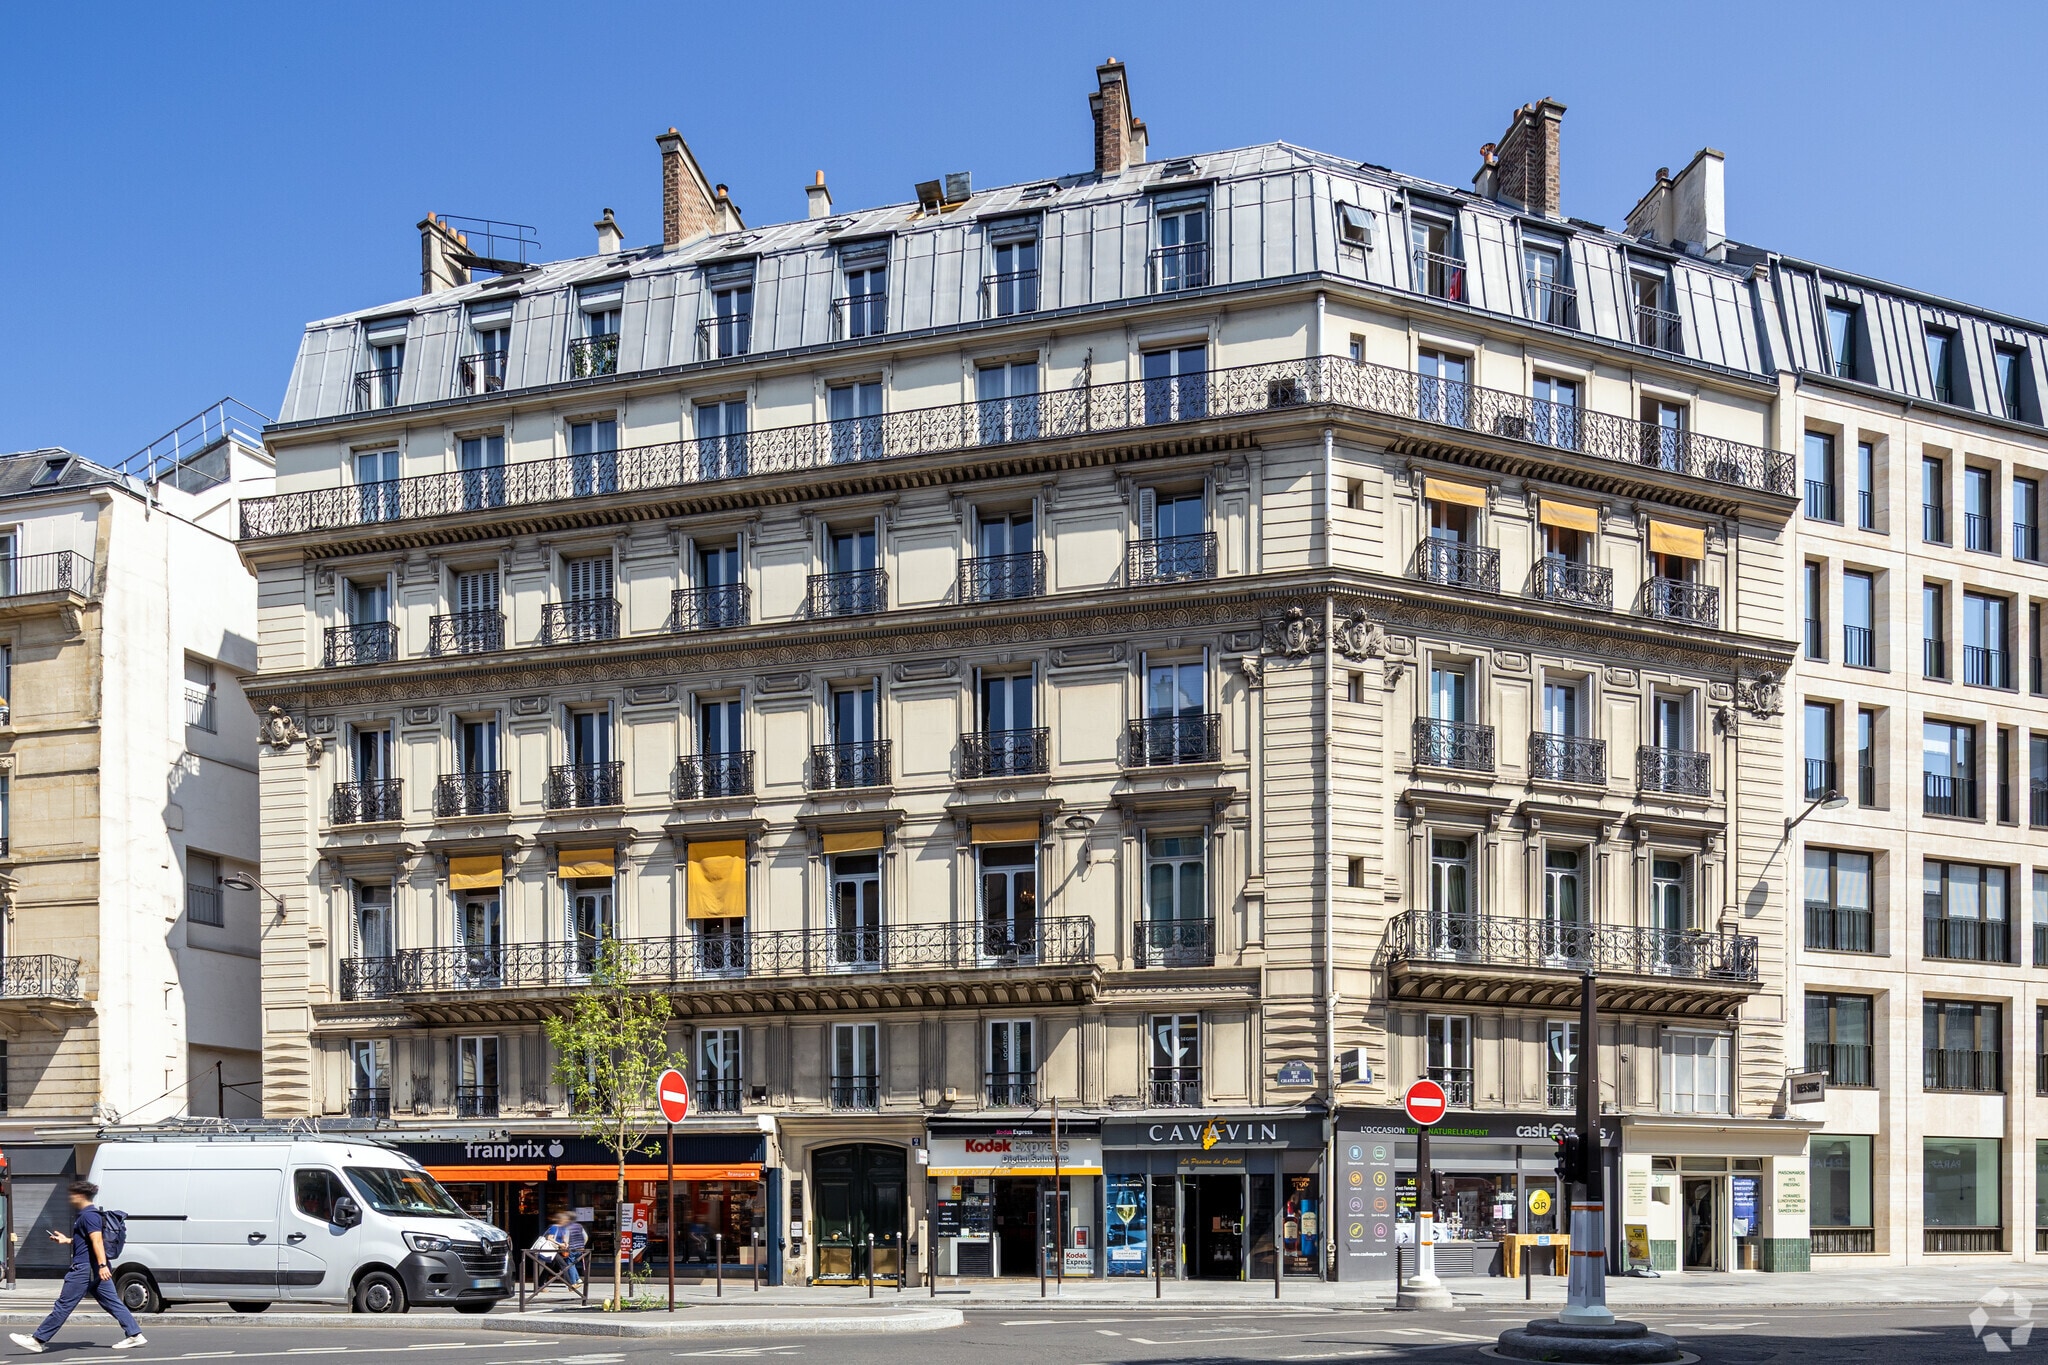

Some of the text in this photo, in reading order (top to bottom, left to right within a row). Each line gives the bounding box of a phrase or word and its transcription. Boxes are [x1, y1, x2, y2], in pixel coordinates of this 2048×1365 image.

[1149, 1124, 1277, 1142] CAVAVIN
[1361, 1126, 1405, 1134] L'OCCASION
[1428, 1128, 1489, 1136] NATURELLEMENT
[465, 1139, 545, 1161] franprix
[965, 1139, 1012, 1153] Kodak
[1002, 1154, 1069, 1164] Digital Solutins
[1190, 1158, 1212, 1166] Passion
[1533, 1201, 1547, 1210] OR
